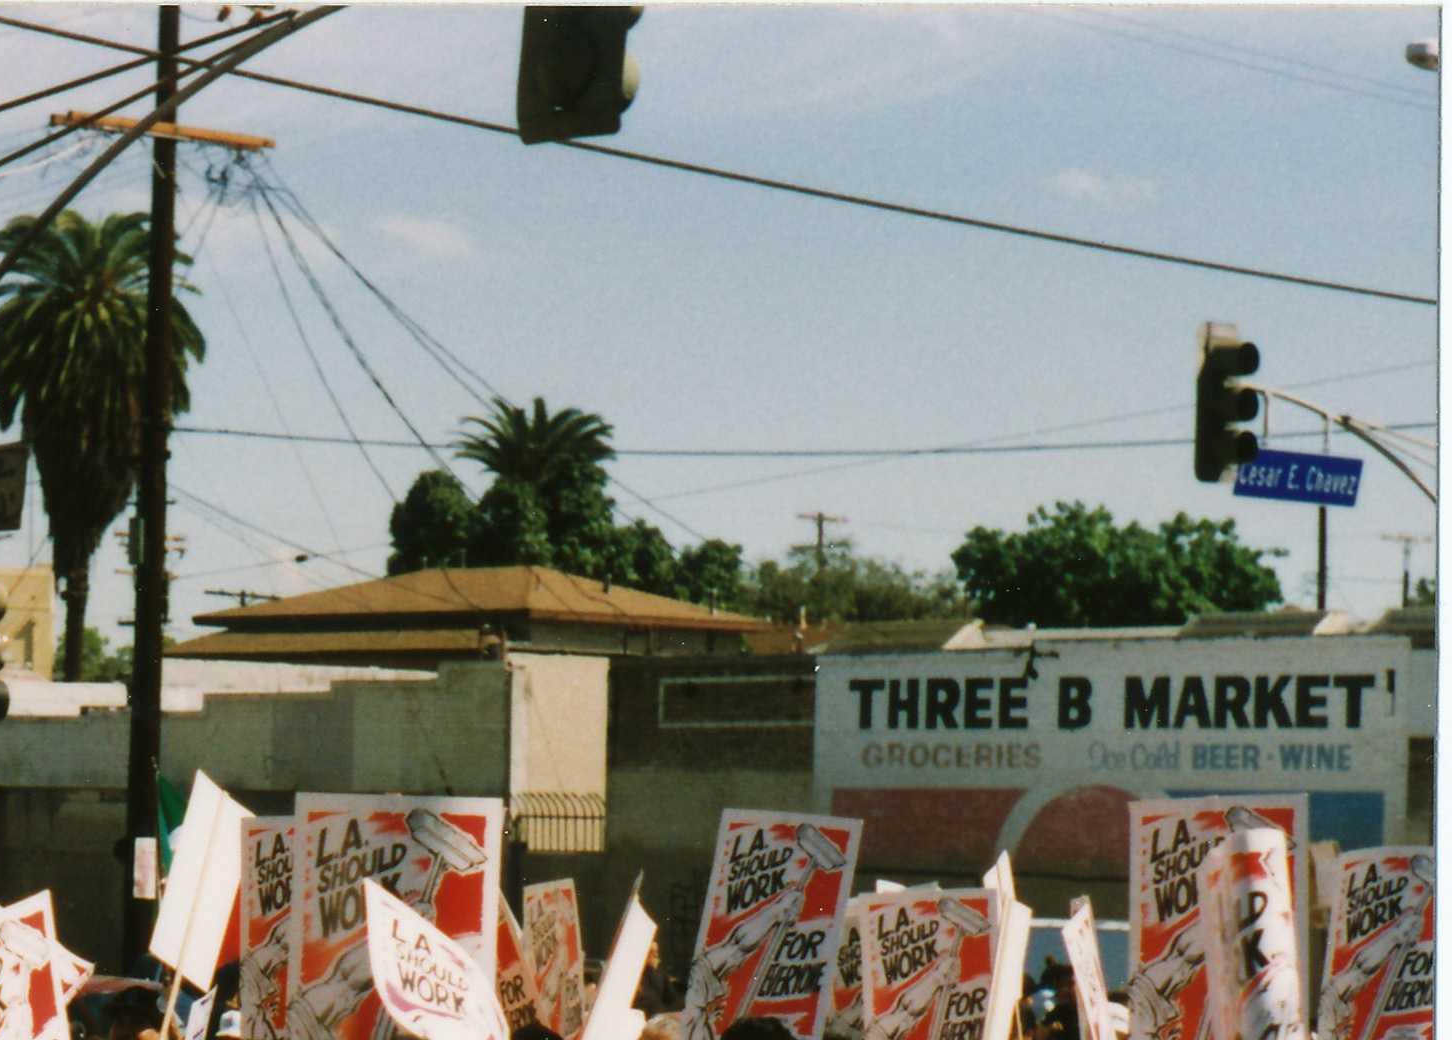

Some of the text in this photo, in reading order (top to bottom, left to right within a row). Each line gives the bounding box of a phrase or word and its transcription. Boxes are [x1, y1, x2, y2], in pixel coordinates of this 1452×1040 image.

[1305, 465, 1358, 495] Chavez
[848, 674, 1375, 730] THREE B MARKET
[861, 743, 1042, 770] GROCERIES
[254, 832, 290, 869] L.A.
[316, 817, 370, 868] L.A.
[729, 828, 769, 863] L.A.
[1150, 818, 1197, 864] L.A.
[318, 842, 408, 894] SHOULD
[727, 847, 794, 881] SHOULD
[1345, 862, 1383, 899] L.A.
[317, 871, 403, 940] WOK
[727, 867, 787, 916] WORK
[1346, 876, 1409, 915] SHOULD
[876, 906, 915, 940] L.A.
[880, 919, 940, 957] SHOULD
[1345, 895, 1403, 945] WORK
[776, 930, 826, 961] FOR
[881, 939, 940, 985] WORK
[397, 960, 466, 1018] WORK
[757, 960, 827, 998] EVERYONE
[944, 987, 988, 1020] FOR
